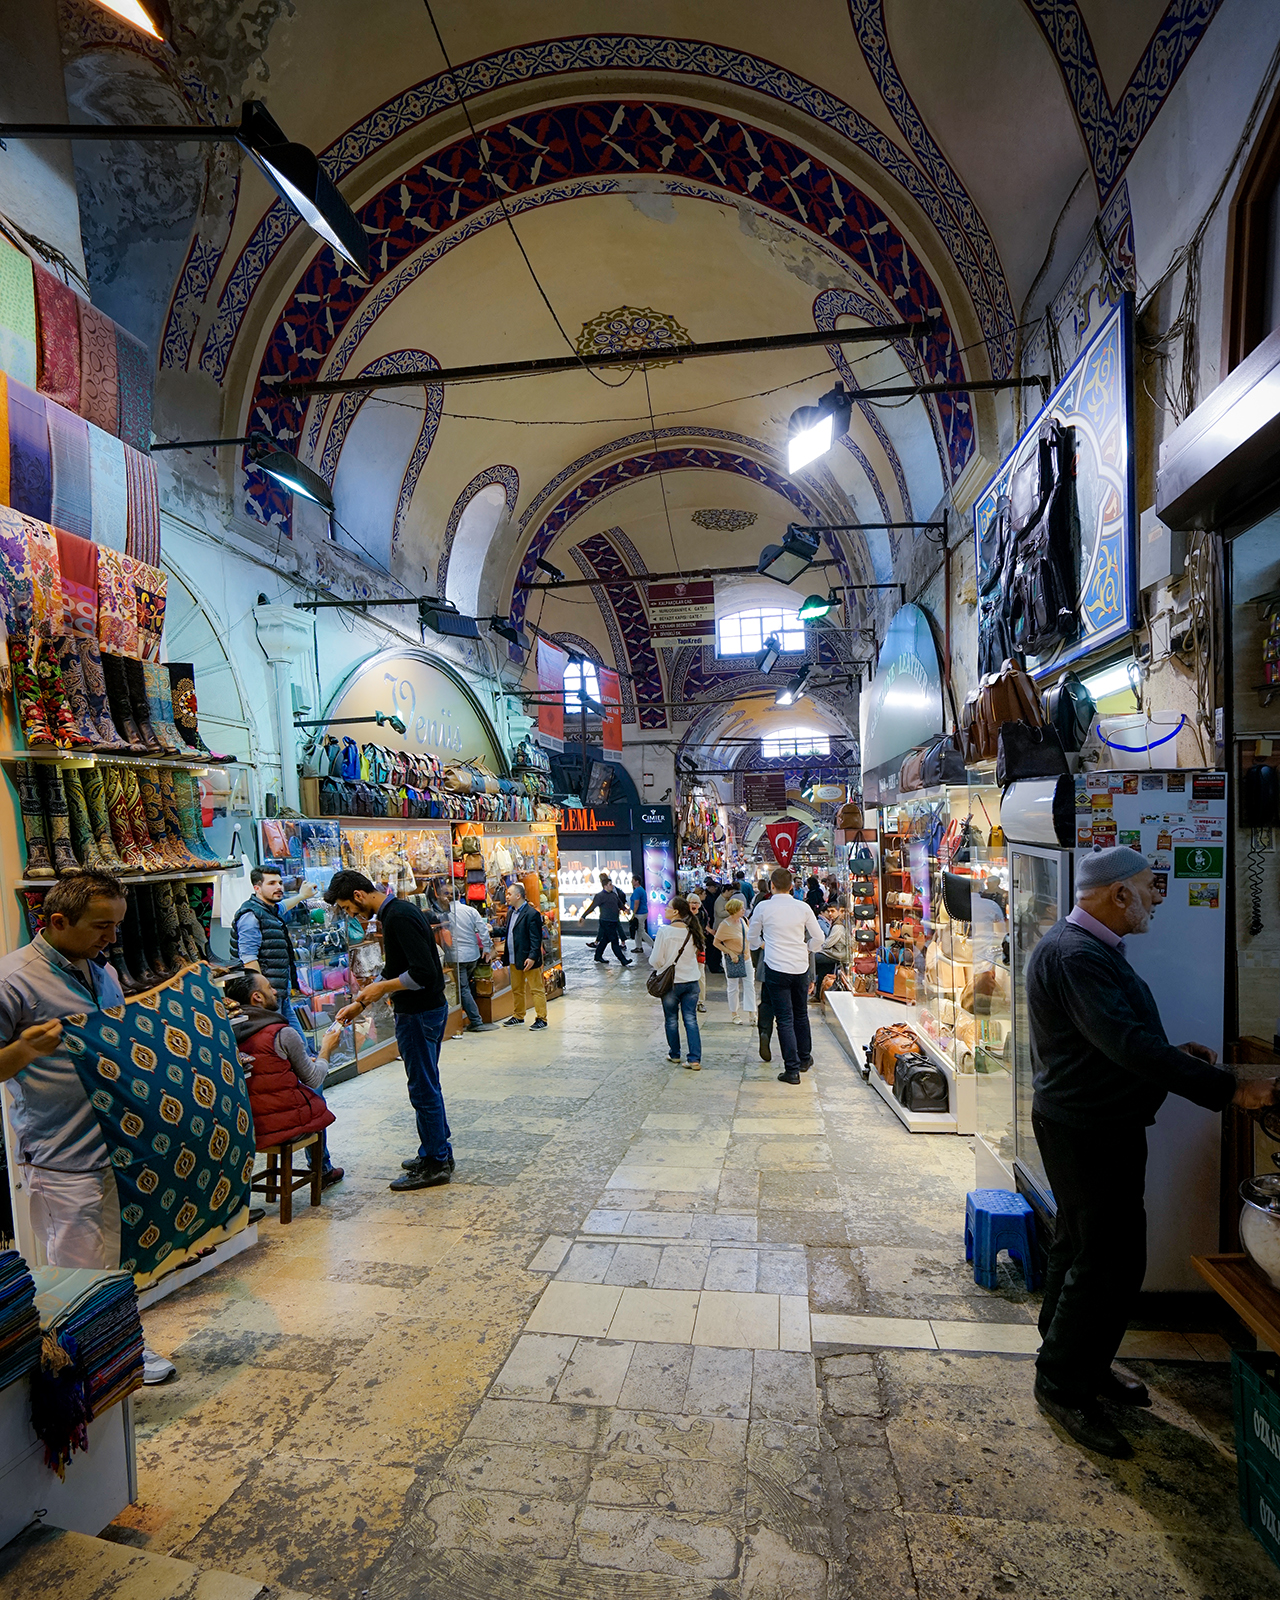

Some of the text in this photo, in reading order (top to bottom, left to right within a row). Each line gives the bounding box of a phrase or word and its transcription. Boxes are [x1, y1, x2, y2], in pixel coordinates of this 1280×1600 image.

[677, 637, 703, 645] YapıKredi
[898, 652, 929, 699] LEATHER
[384, 672, 463, 753] Venüs
[560, 808, 598, 831] LEMA
[607, 860, 622, 869] LEMA
